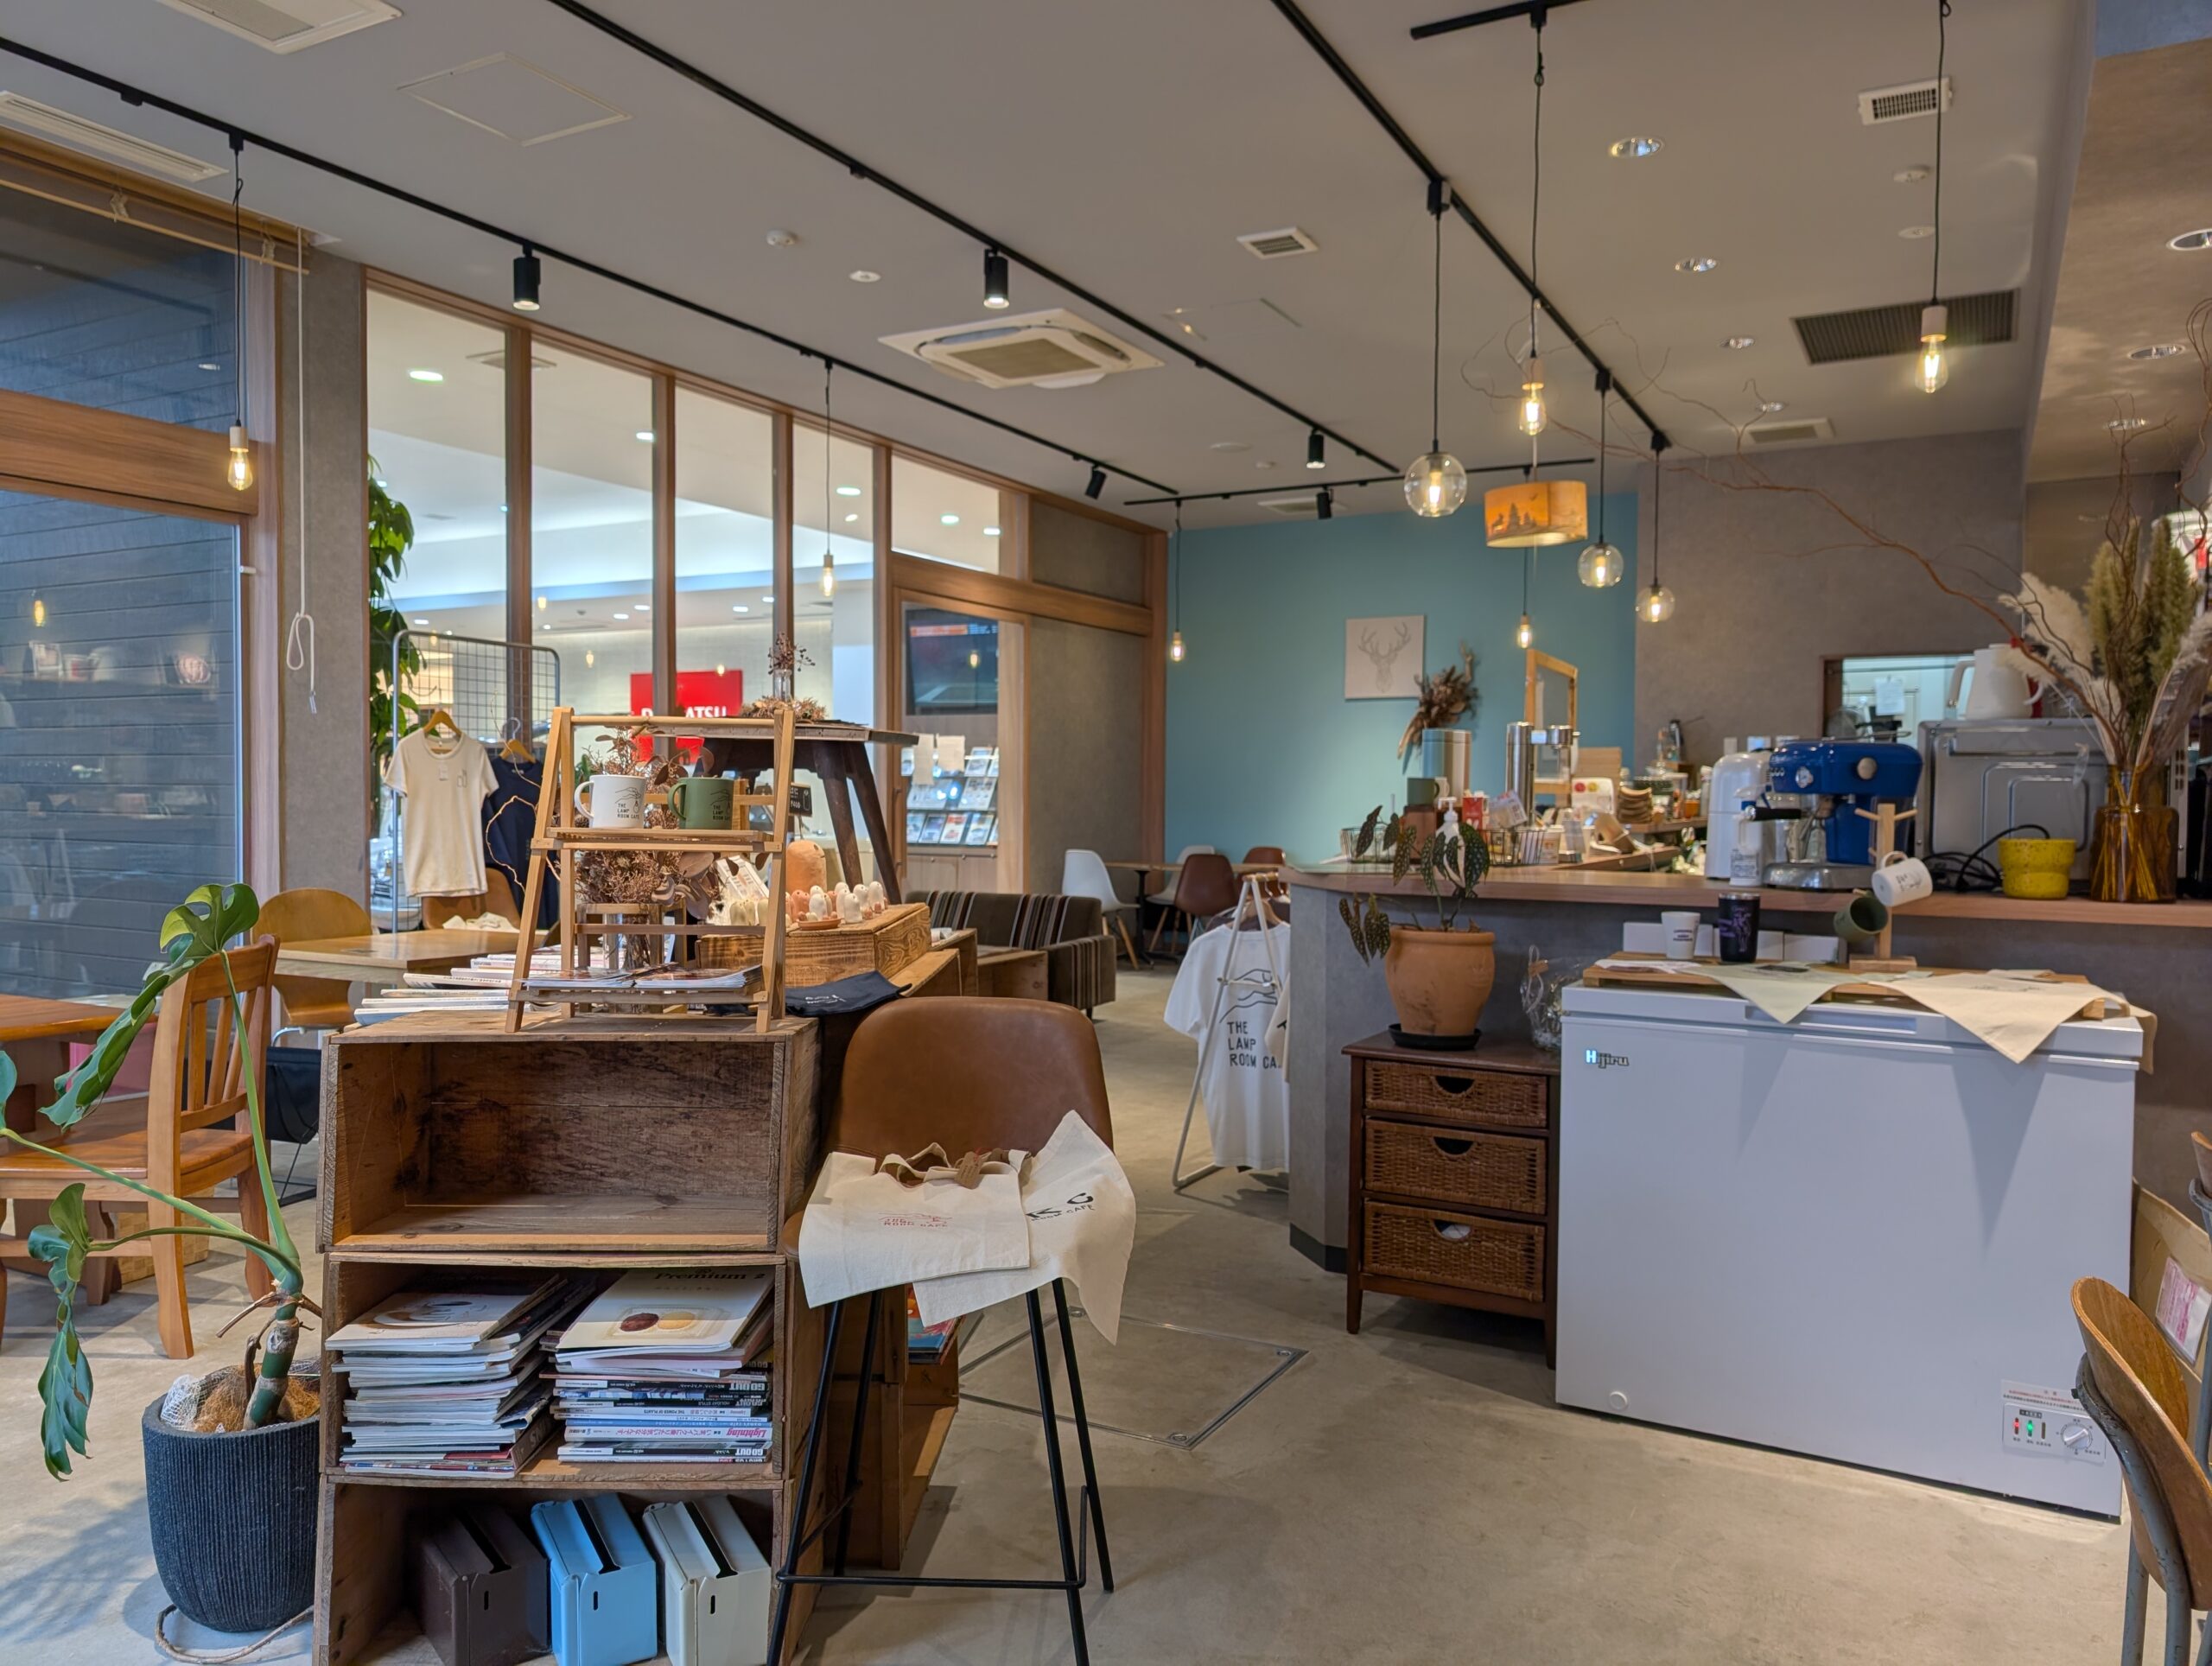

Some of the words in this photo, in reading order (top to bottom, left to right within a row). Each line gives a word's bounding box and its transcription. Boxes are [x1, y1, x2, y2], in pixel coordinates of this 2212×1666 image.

[641, 706, 728, 718] DATSU
[1227, 1021, 1249, 1034] THE
[1228, 1037, 1256, 1051] LAMP
[1229, 1052, 1257, 1068] ROOM
[1065, 1204, 1096, 1214] CAFE
[728, 1383, 750, 1391] OUT
[751, 1383, 766, 1391] GO
[726, 1428, 767, 1438] Lightning
